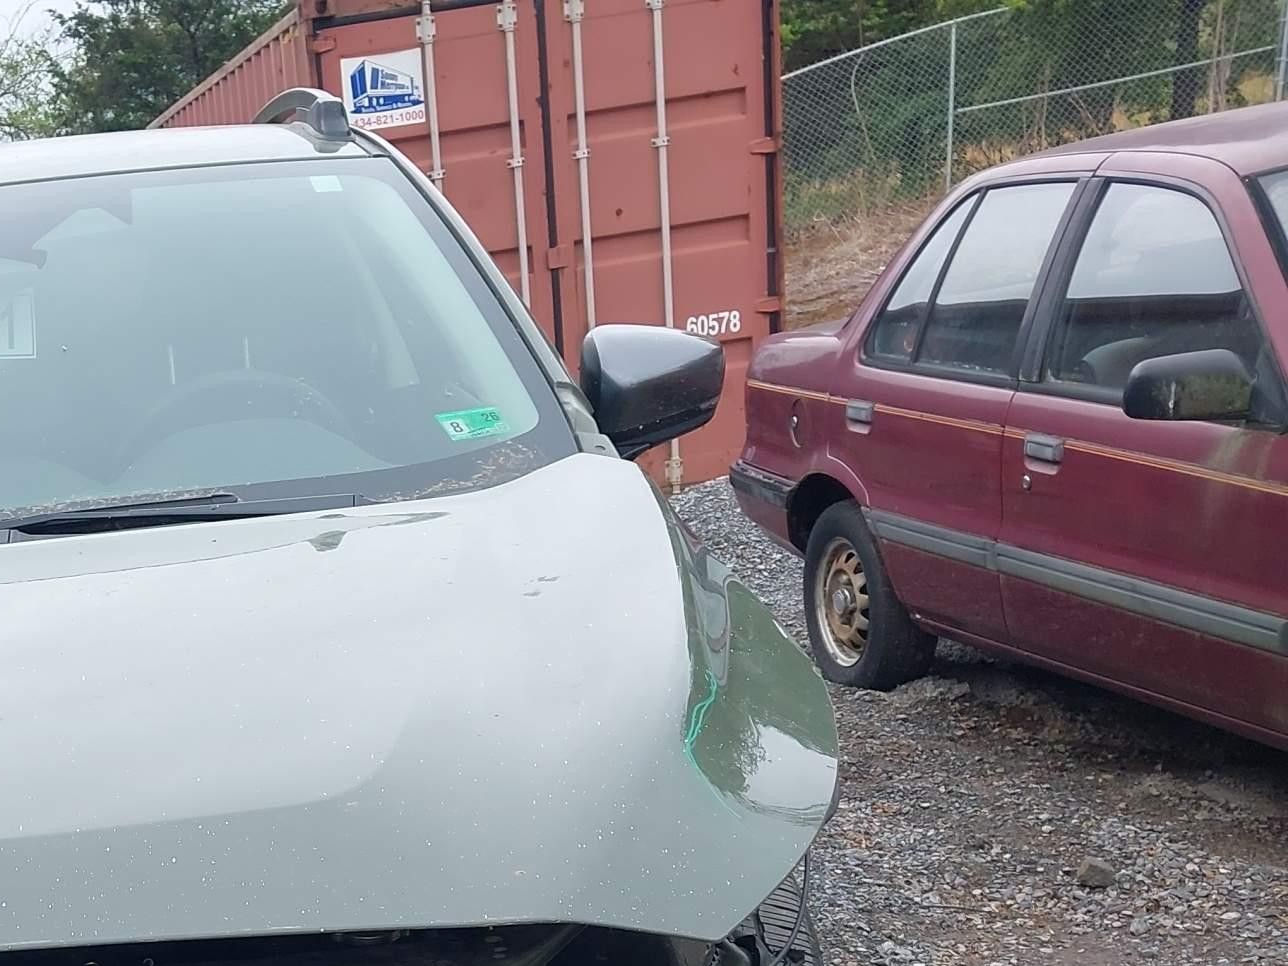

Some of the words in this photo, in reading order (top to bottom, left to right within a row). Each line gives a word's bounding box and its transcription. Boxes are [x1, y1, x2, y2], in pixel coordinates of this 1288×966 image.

[686, 310, 741, 336] 60578
[480, 411, 500, 422] 26
[449, 421, 464, 433] 8
